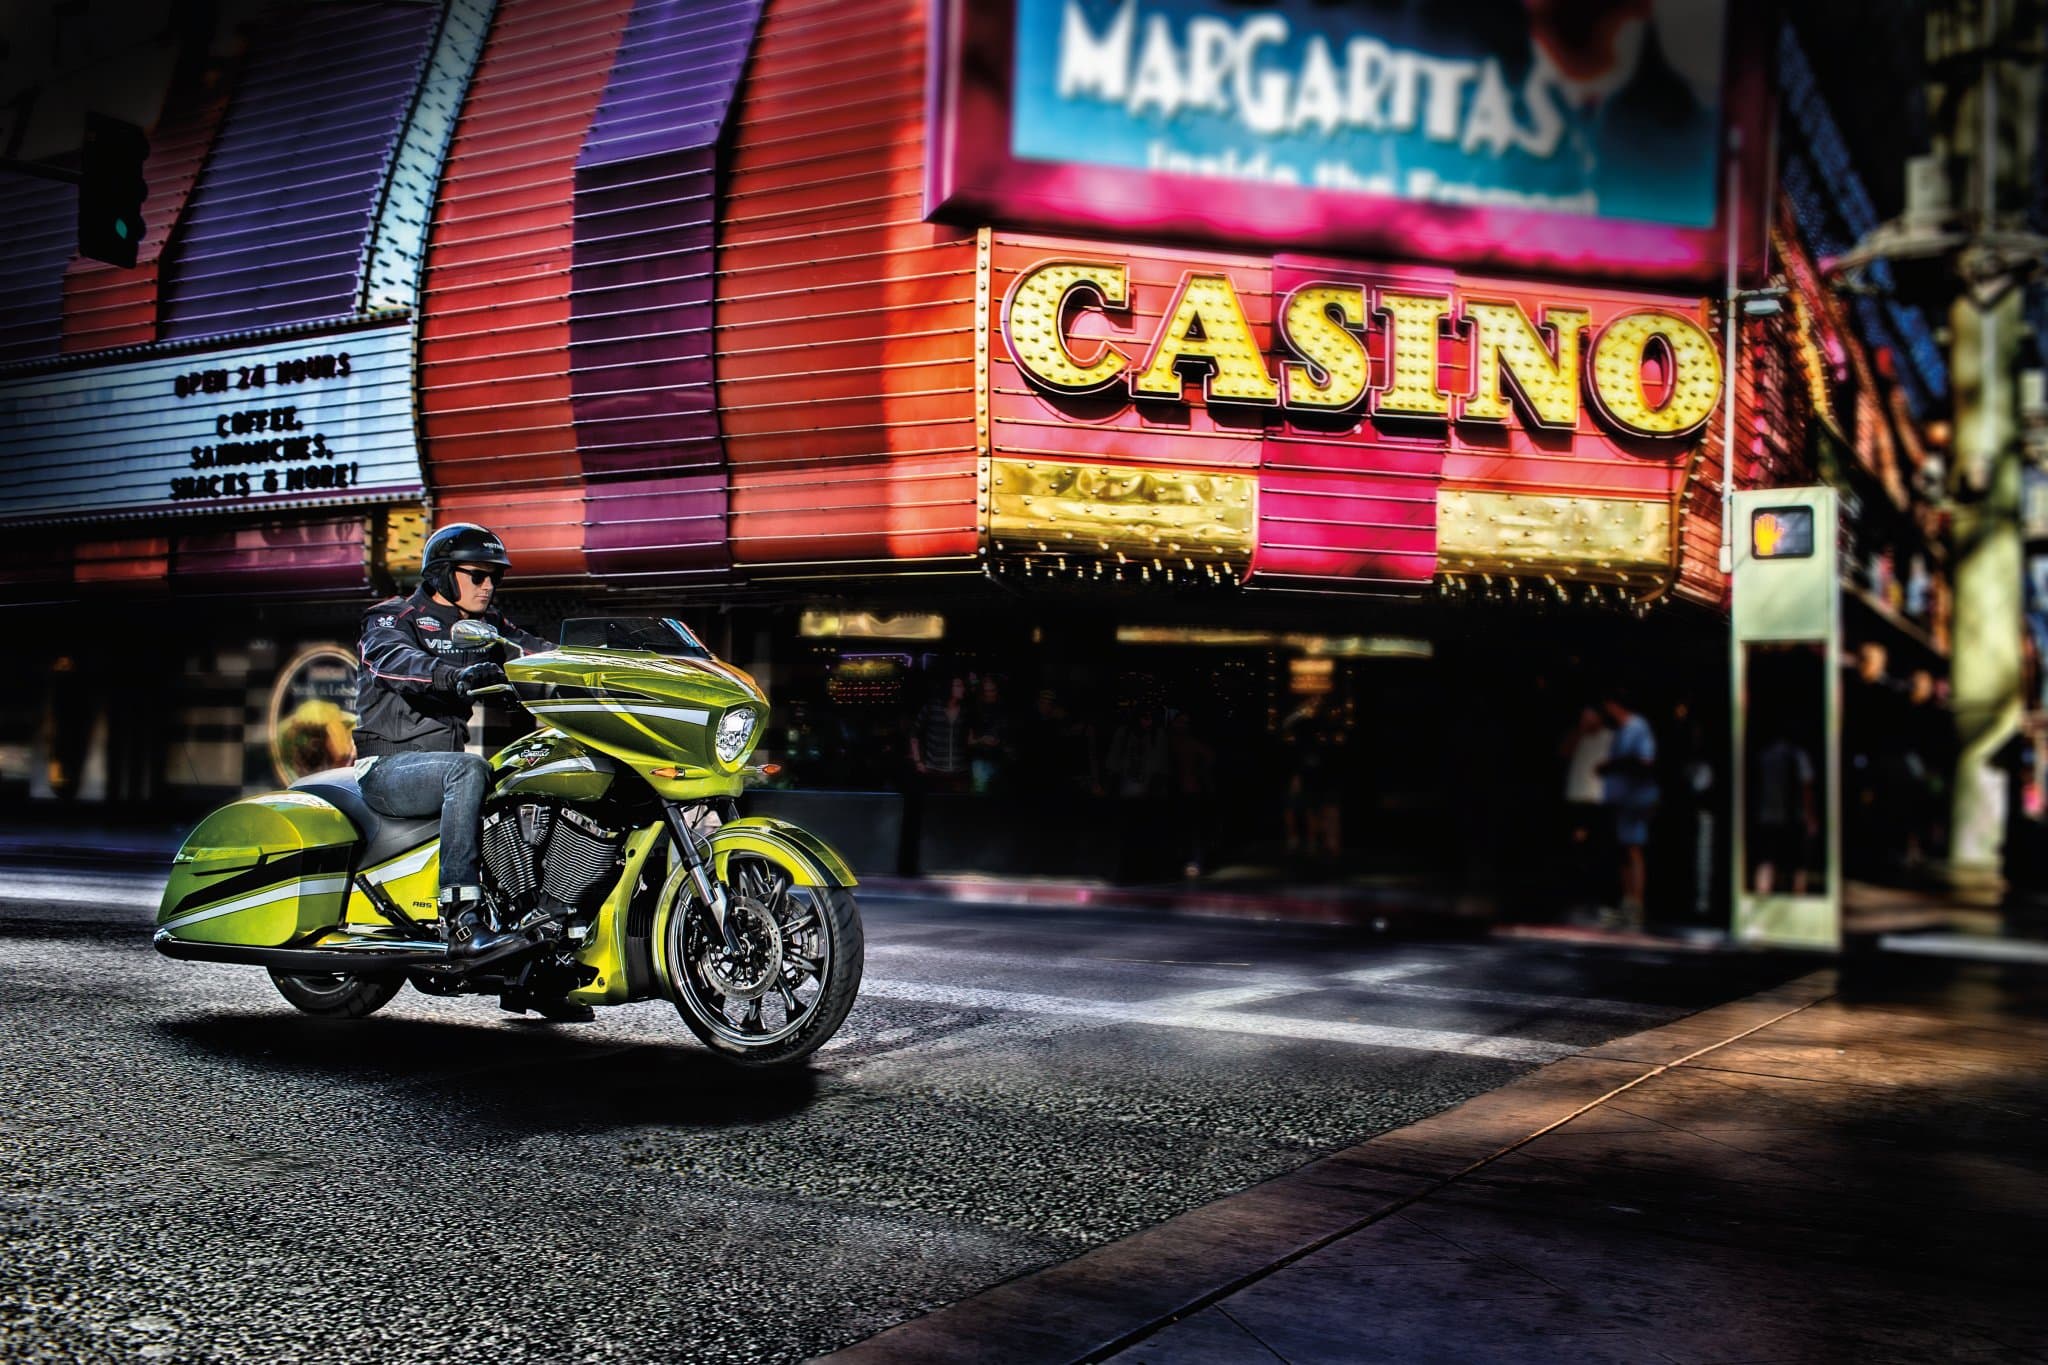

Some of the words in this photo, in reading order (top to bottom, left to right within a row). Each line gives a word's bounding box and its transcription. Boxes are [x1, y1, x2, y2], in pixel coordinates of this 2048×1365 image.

[1060, 0, 1565, 158] MARGARITAS
[1003, 257, 1723, 438] CASINO
[174, 368, 229, 398] OPEN
[238, 364, 266, 391] 24
[277, 352, 352, 386] HOURS
[216, 405, 304, 438] COFFEE,
[190, 433, 334, 470] SANDWICHES,
[169, 471, 251, 500] SNACKS
[286, 461, 358, 491] MORE!
